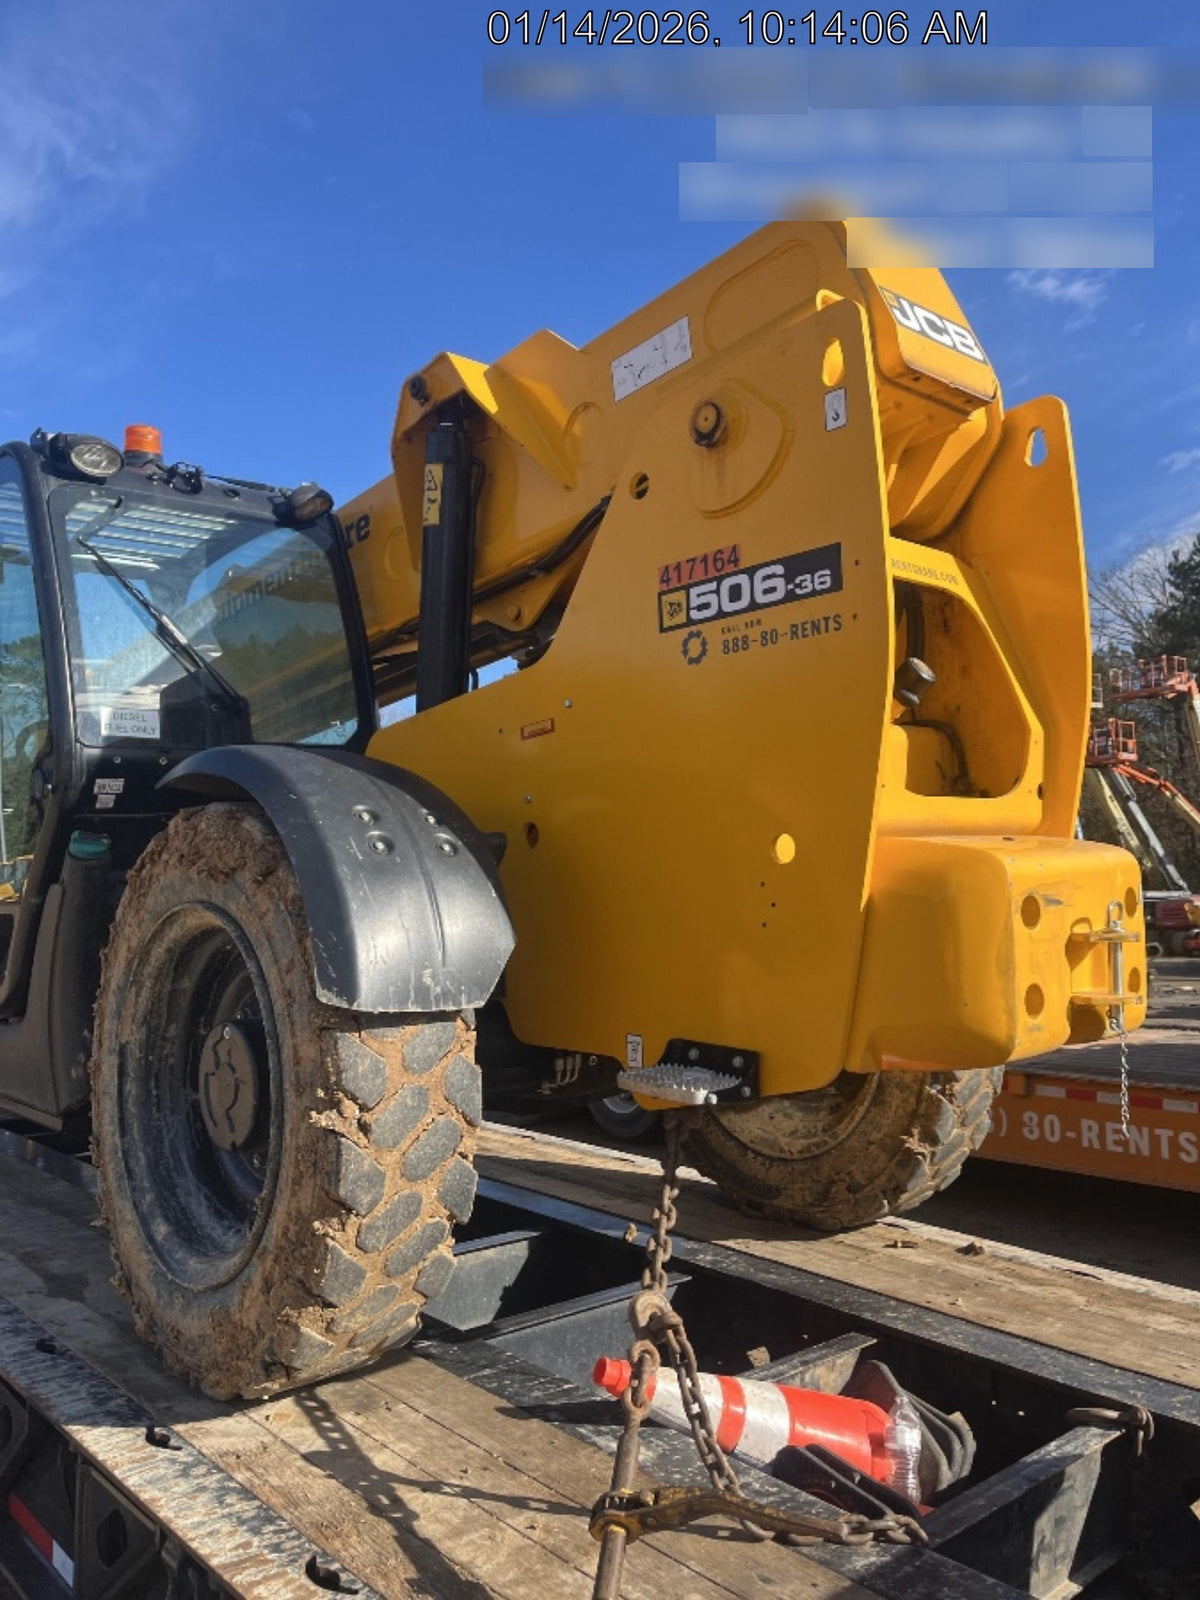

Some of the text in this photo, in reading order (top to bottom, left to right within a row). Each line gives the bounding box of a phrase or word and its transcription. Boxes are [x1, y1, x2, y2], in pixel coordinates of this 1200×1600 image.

[891, 297, 986, 362] JCB
[660, 543, 740, 588] 417164
[722, 614, 842, 655] 888-80-RENTS
[1022, 1109, 1199, 1164] 80-RENTS
